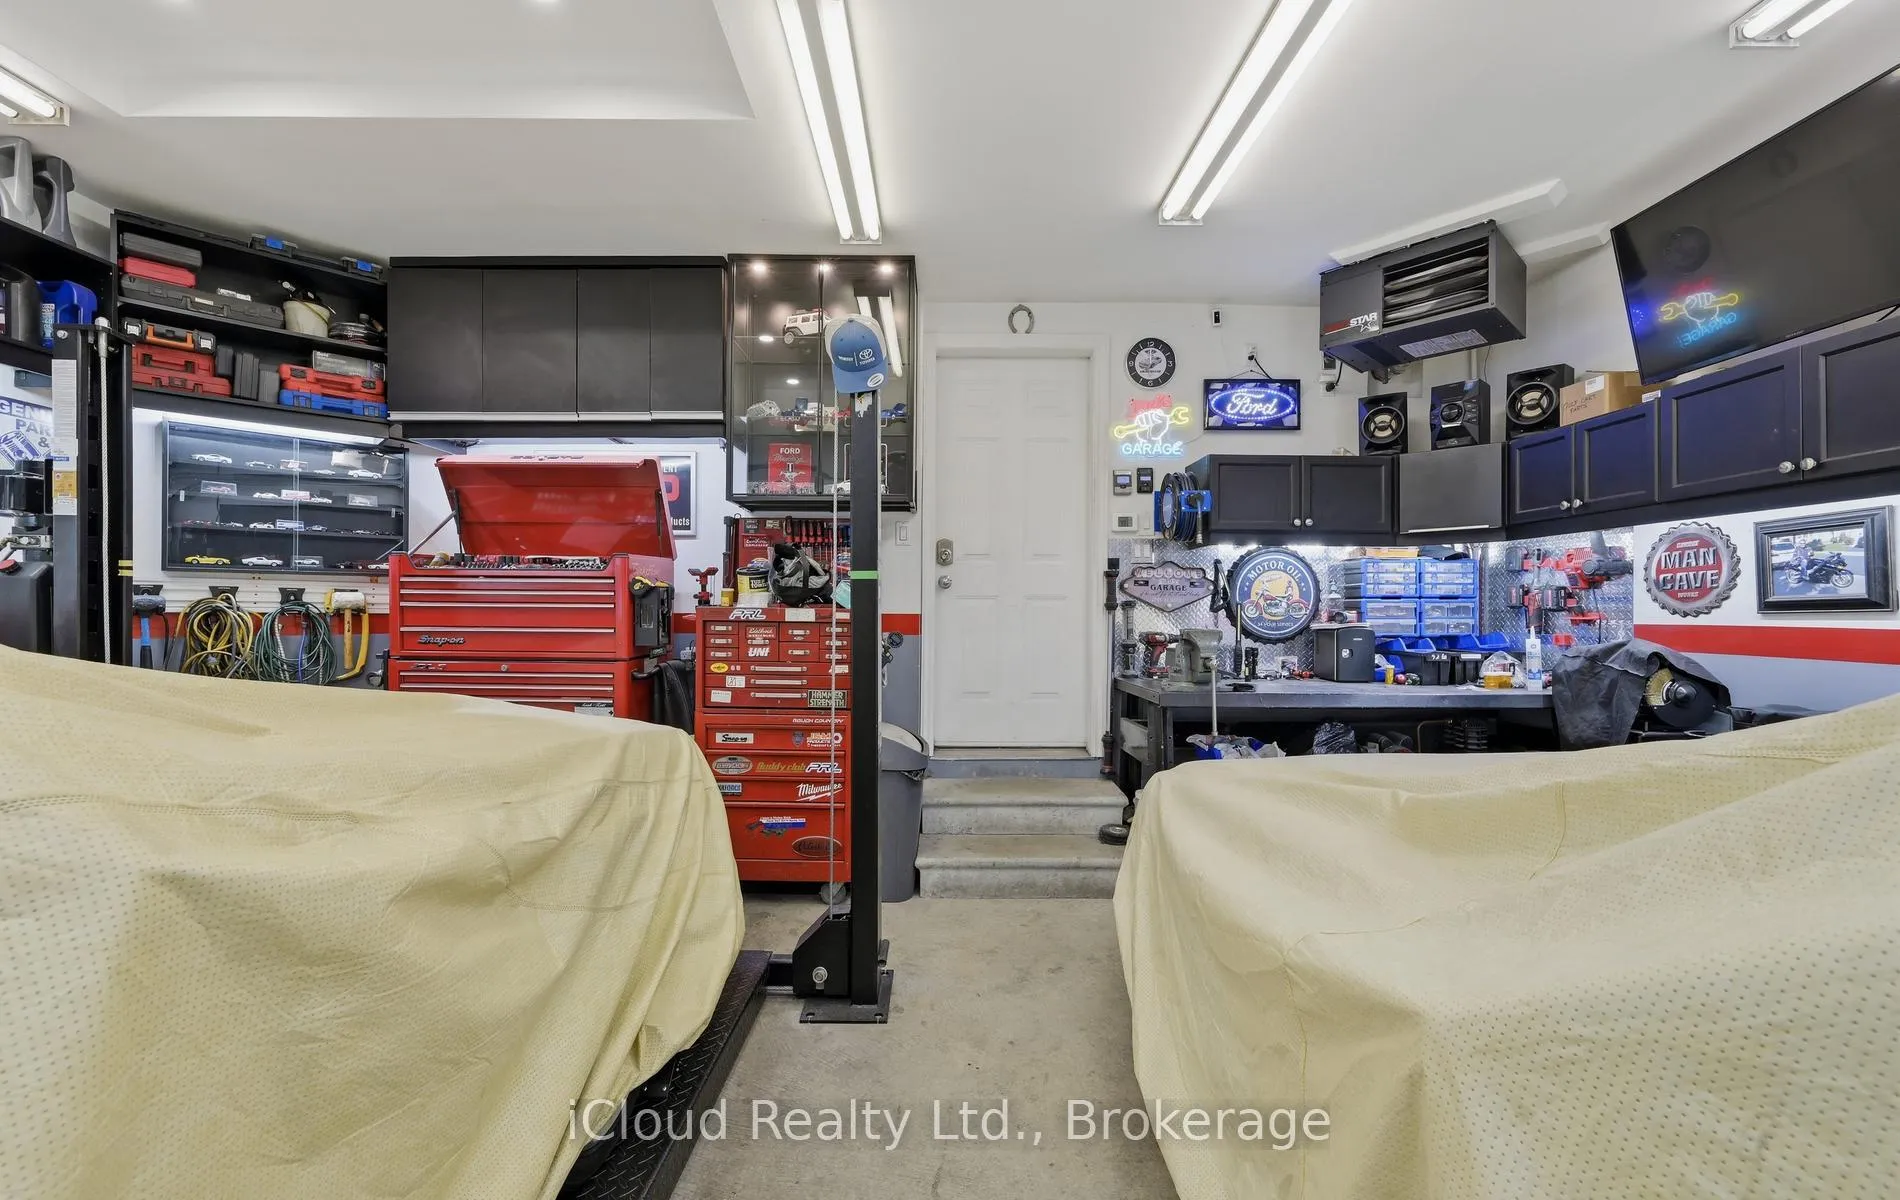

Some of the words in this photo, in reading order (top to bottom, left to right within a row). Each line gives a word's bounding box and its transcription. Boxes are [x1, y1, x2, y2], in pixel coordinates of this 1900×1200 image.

[1350, 312, 1378, 326] STAR
[1226, 392, 1278, 415] Ford
[38, 437, 50, 449] &
[1121, 443, 1182, 456] GARAGE
[779, 447, 801, 455] FORD
[1660, 546, 1718, 570] MAN
[1246, 560, 1285, 581] MOTOR
[1286, 565, 1302, 581] OIL
[1658, 570, 1720, 592] CAVE
[1150, 584, 1187, 592] GARAGE
[748, 647, 770, 657] UNI
[755, 762, 786, 773] Buddy
[796, 782, 843, 797] Milwauee
